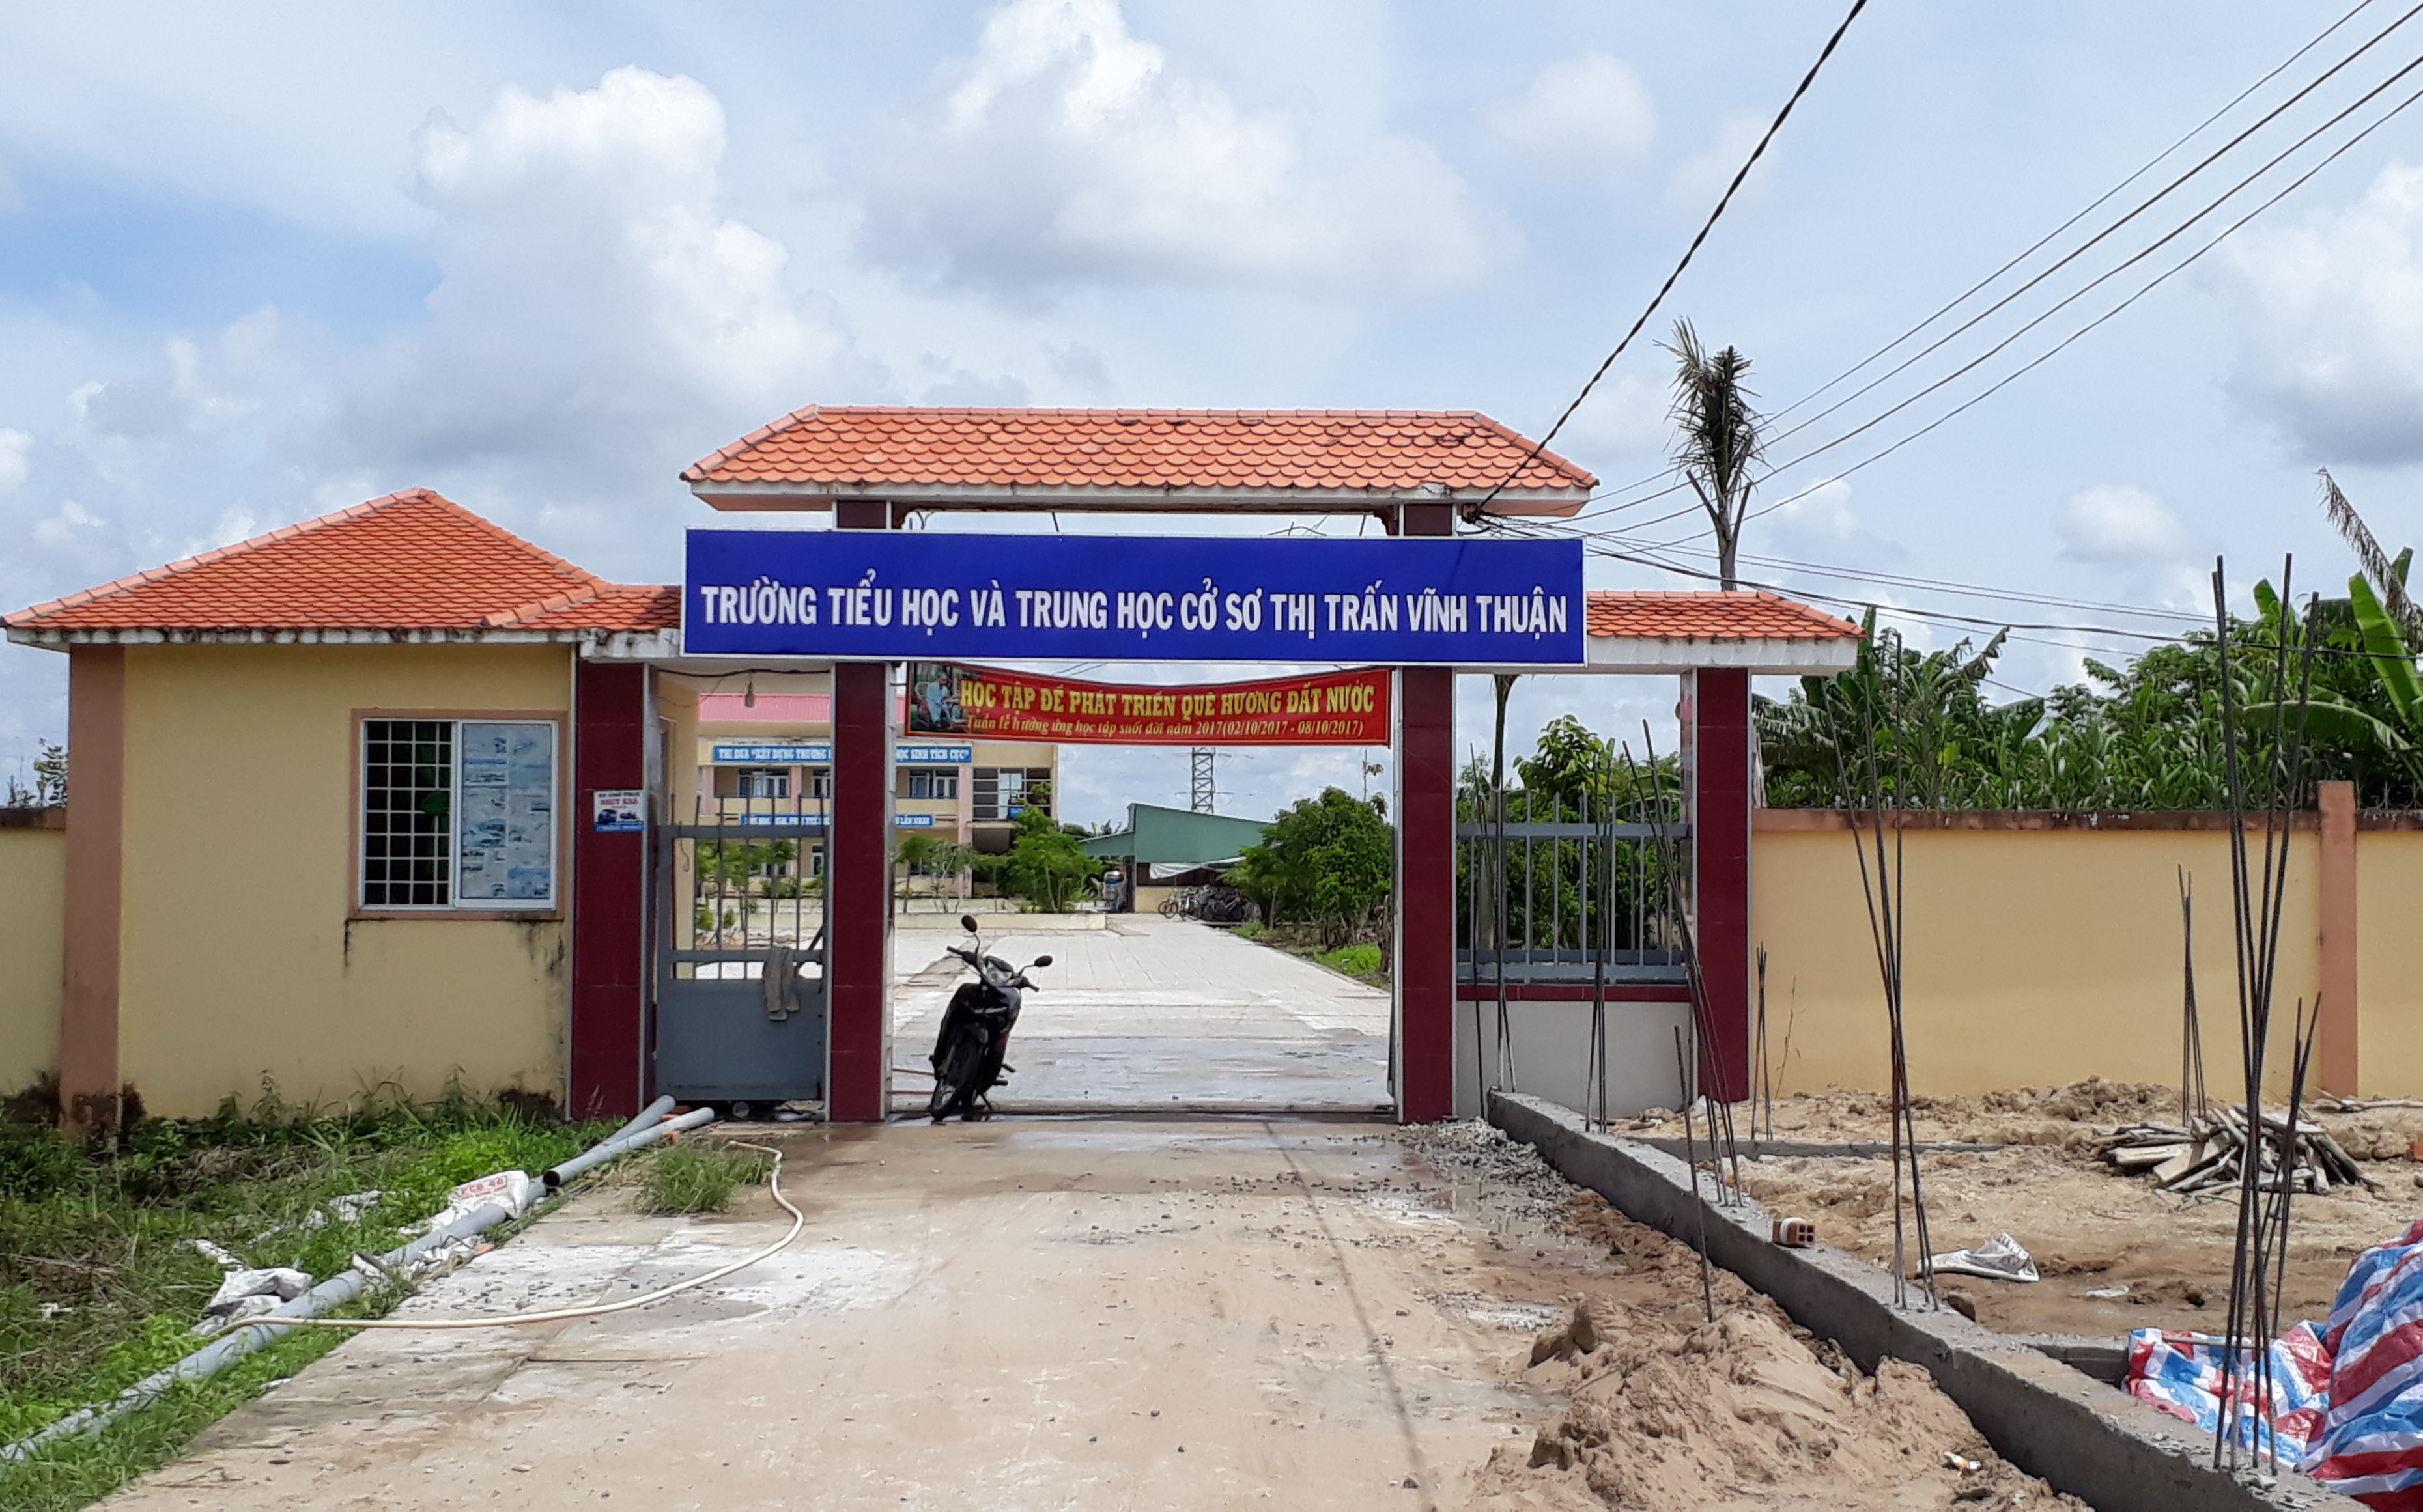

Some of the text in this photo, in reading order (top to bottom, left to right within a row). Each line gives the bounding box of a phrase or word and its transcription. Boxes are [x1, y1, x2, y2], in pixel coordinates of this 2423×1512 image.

[700, 575, 817, 625] TRƯỜNG
[827, 568, 892, 626] TIỂU
[901, 588, 959, 636] HỌC
[970, 580, 1006, 627] VÀ
[1015, 590, 1107, 629] TRUNG
[1117, 591, 1173, 639] HỌC
[1180, 577, 1219, 631] CỞ
[1269, 594, 1315, 639] THỊ
[1324, 580, 1398, 632] TRẤN
[1406, 587, 1467, 632] VĨNH
[1475, 586, 1566, 640] THUẬN
[960, 680, 997, 714] HỌC
[1001, 681, 1036, 716] TẬP
[1068, 690, 1117, 716] PHÁT
[1181, 692, 1216, 721] QUÊ
[1220, 690, 1282, 715] HƯƠNG
[1286, 682, 1322, 714] ĐẤT
[1326, 679, 1375, 714] NƯỚC
[1076, 720, 1096, 736] học
[1098, 721, 1117, 738] tập
[1119, 721, 1142, 735] suốt
[1297, 720, 1363, 737] 08/10/2017)
